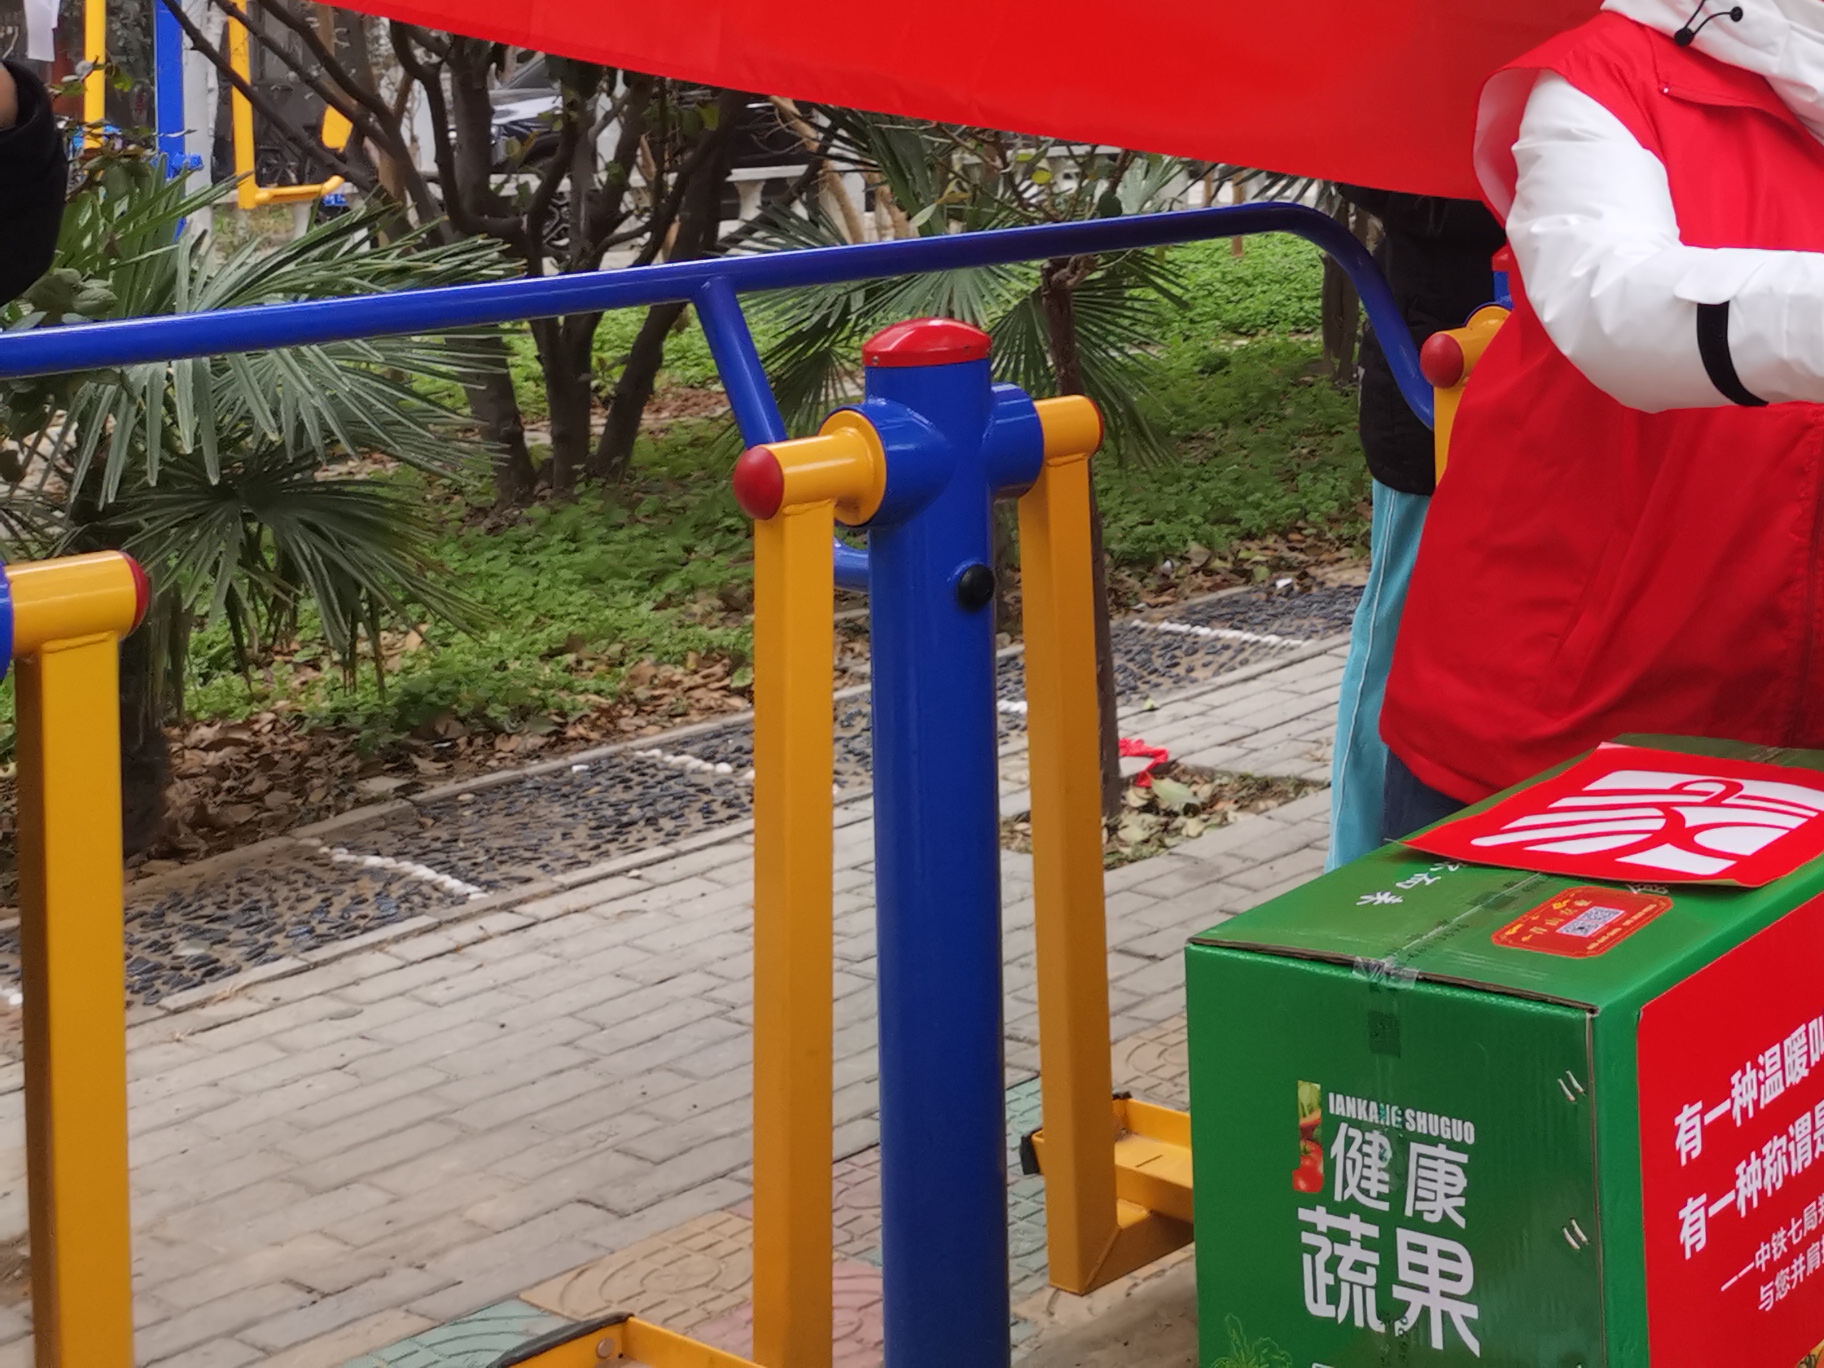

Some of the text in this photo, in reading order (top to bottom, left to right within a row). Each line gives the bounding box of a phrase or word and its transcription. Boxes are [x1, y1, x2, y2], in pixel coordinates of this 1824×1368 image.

[1330, 1122, 1469, 1230] 健康
[1405, 1109, 1476, 1146] SHUGUO
[1298, 1206, 1481, 1359] 蔬果
